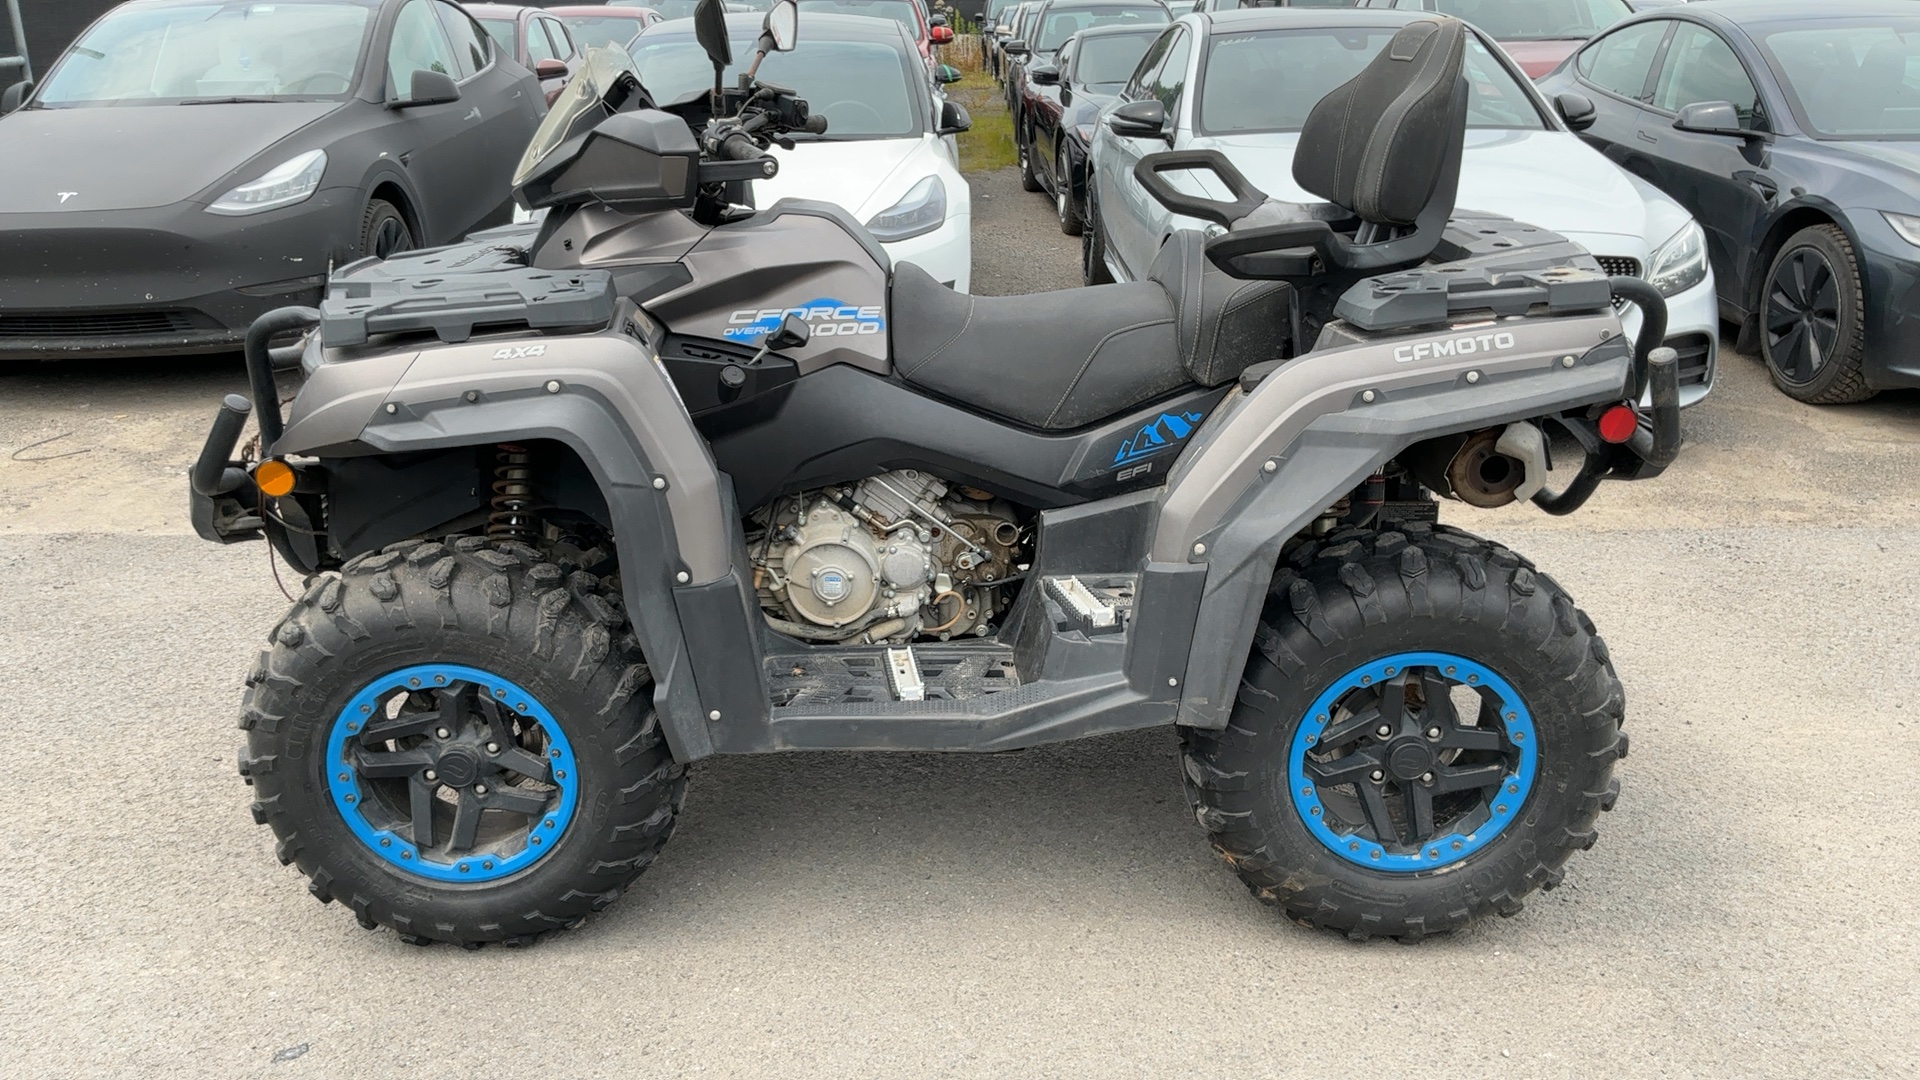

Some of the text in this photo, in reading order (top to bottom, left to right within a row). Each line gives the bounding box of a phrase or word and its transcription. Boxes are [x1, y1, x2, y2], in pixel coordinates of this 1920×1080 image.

[729, 306, 882, 324] CFORCE
[722, 326, 780, 336] OVERL
[1393, 332, 1515, 362] CFMOTO
[1116, 462, 1153, 481] EFI
